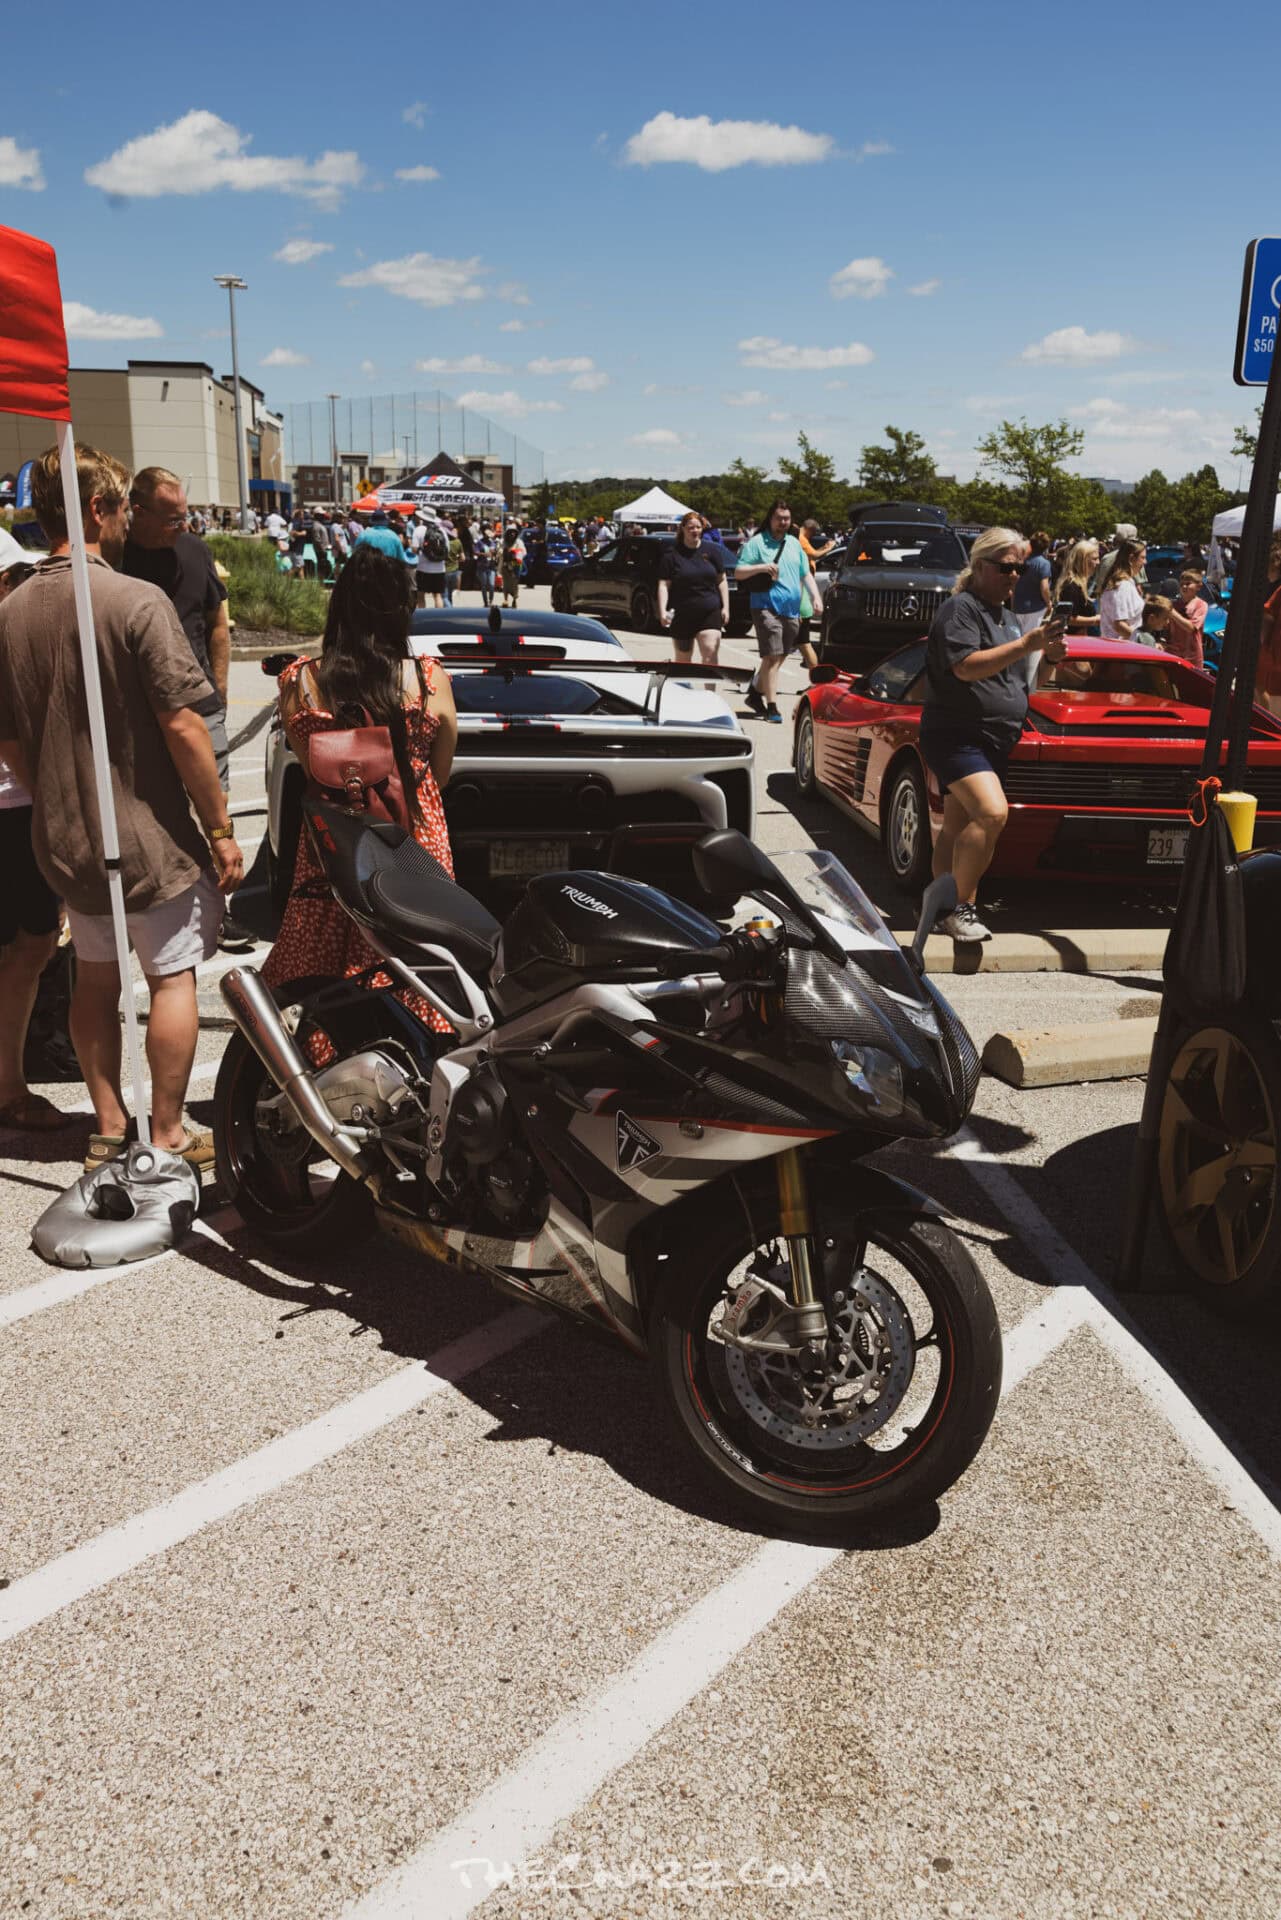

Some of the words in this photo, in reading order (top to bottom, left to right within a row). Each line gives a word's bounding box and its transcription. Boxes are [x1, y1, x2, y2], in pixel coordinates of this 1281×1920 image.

[432, 475, 464, 486] STL
[469, 495, 497, 505] CLUB
[1150, 838, 1173, 856] 239
[560, 885, 618, 920] TRIUMPH
[624, 1120, 651, 1147] TRIUMPH
[728, 1290, 752, 1322] brembo
